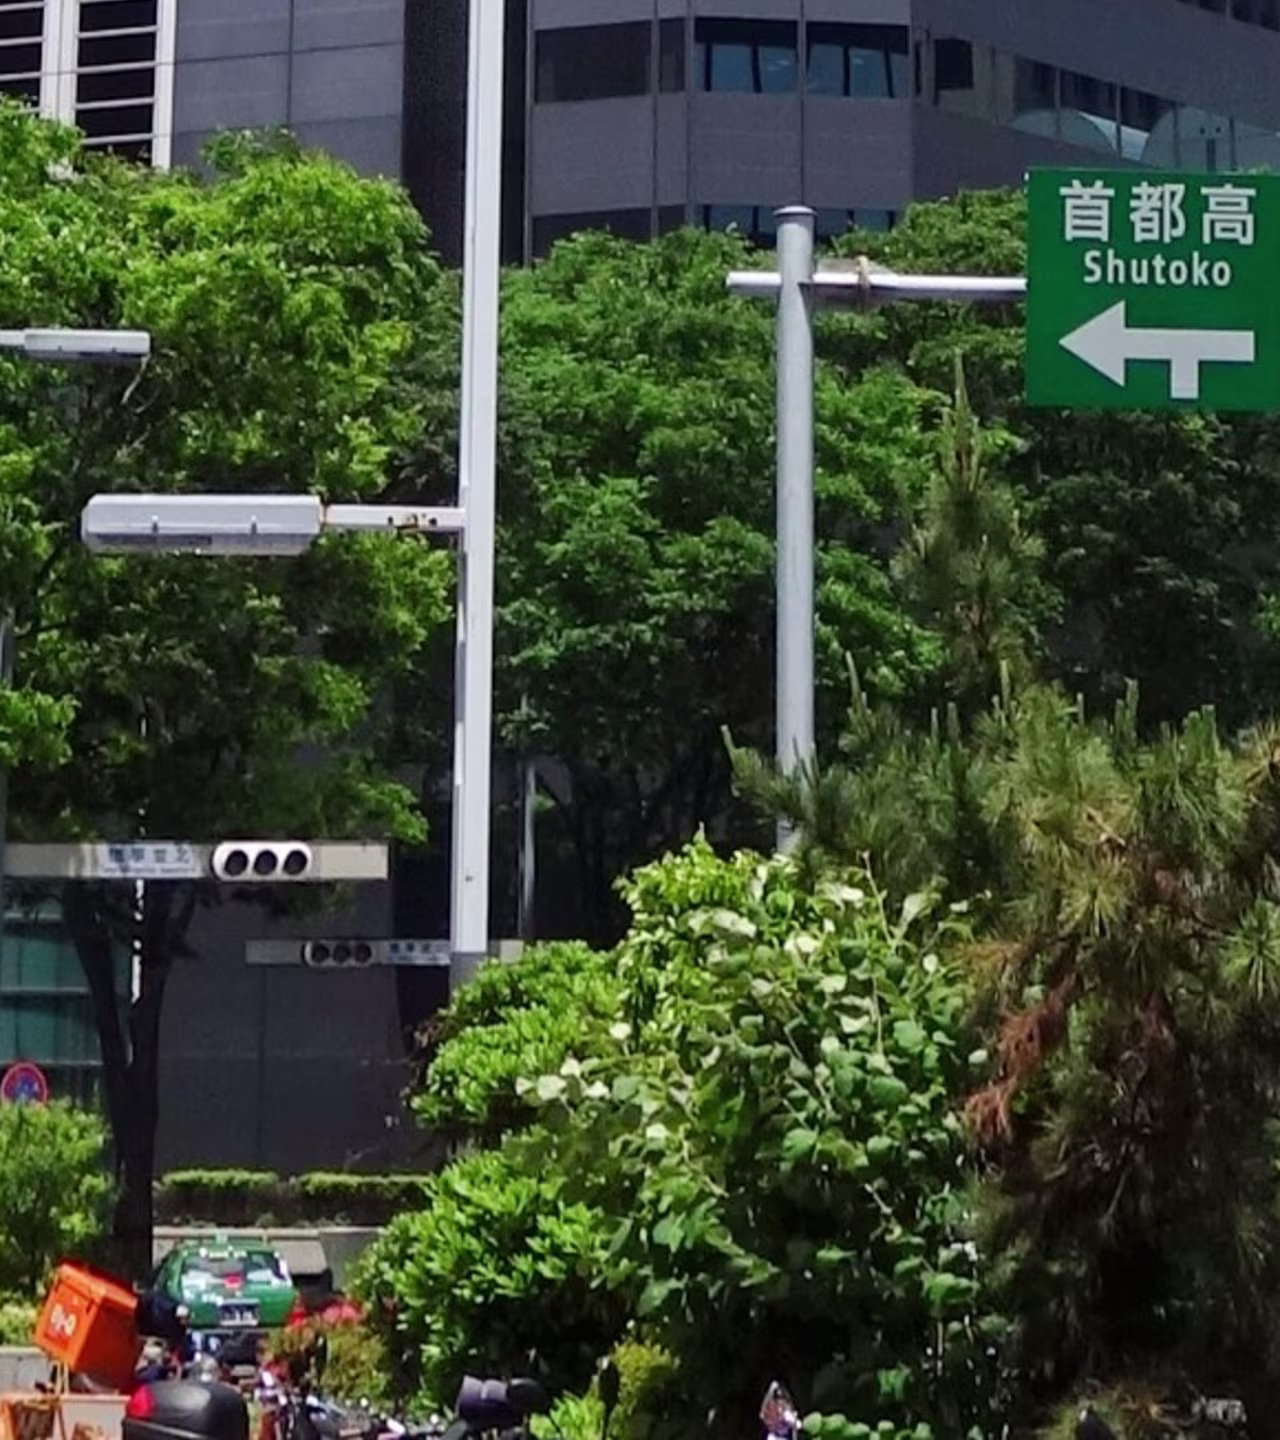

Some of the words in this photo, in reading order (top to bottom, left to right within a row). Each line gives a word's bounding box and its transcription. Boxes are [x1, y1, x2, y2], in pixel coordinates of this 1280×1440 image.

[1059, 179, 1256, 245] 首都高
[1083, 248, 1231, 286] Shutoko
